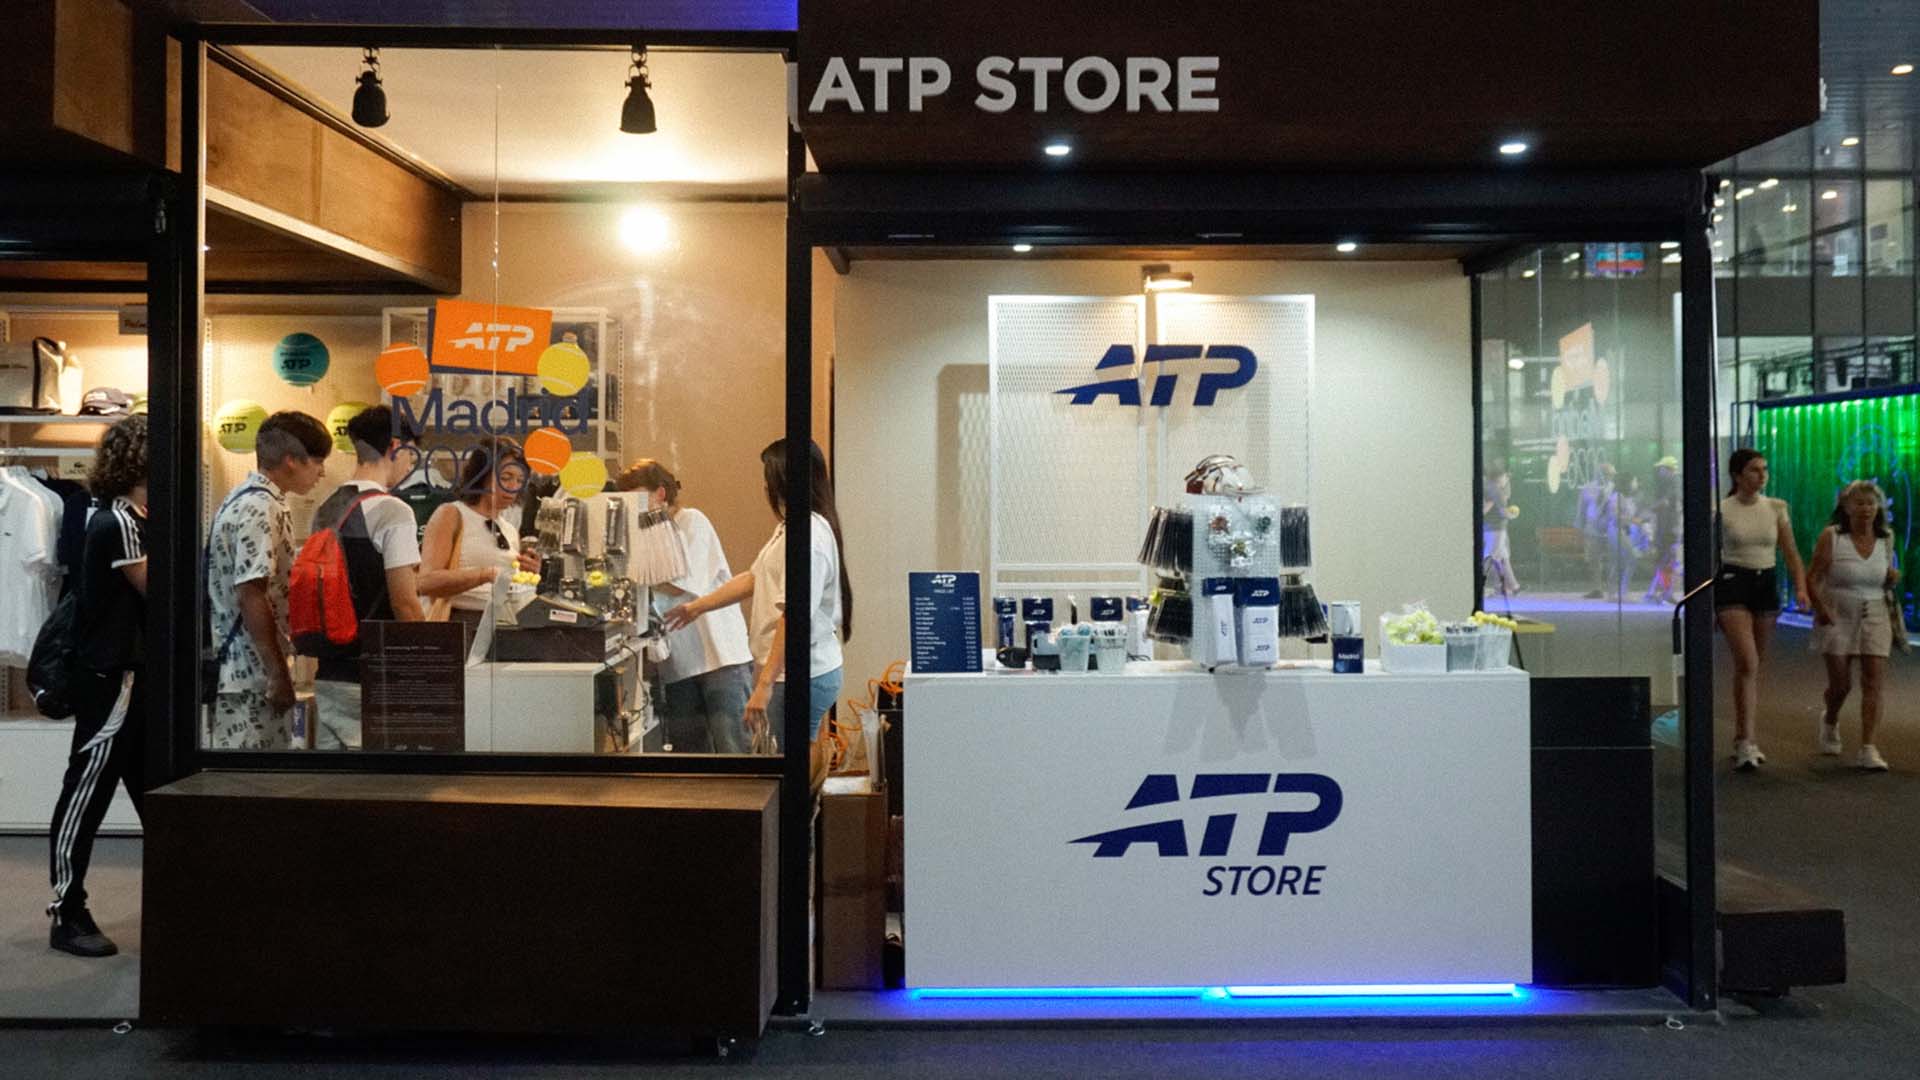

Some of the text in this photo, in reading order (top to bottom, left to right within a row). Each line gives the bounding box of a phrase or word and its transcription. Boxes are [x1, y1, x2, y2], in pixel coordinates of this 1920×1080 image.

[808, 56, 1220, 113] ATP STORE
[448, 322, 535, 352] ATP
[281, 358, 312, 370] ATP
[1052, 344, 1258, 406] ATP
[218, 422, 247, 434] ATP
[391, 386, 590, 436] Madrid
[389, 444, 530, 496] 2026
[931, 574, 957, 584] ATP
[1066, 773, 1343, 858] ATP
[1203, 865, 1326, 896] STORE
